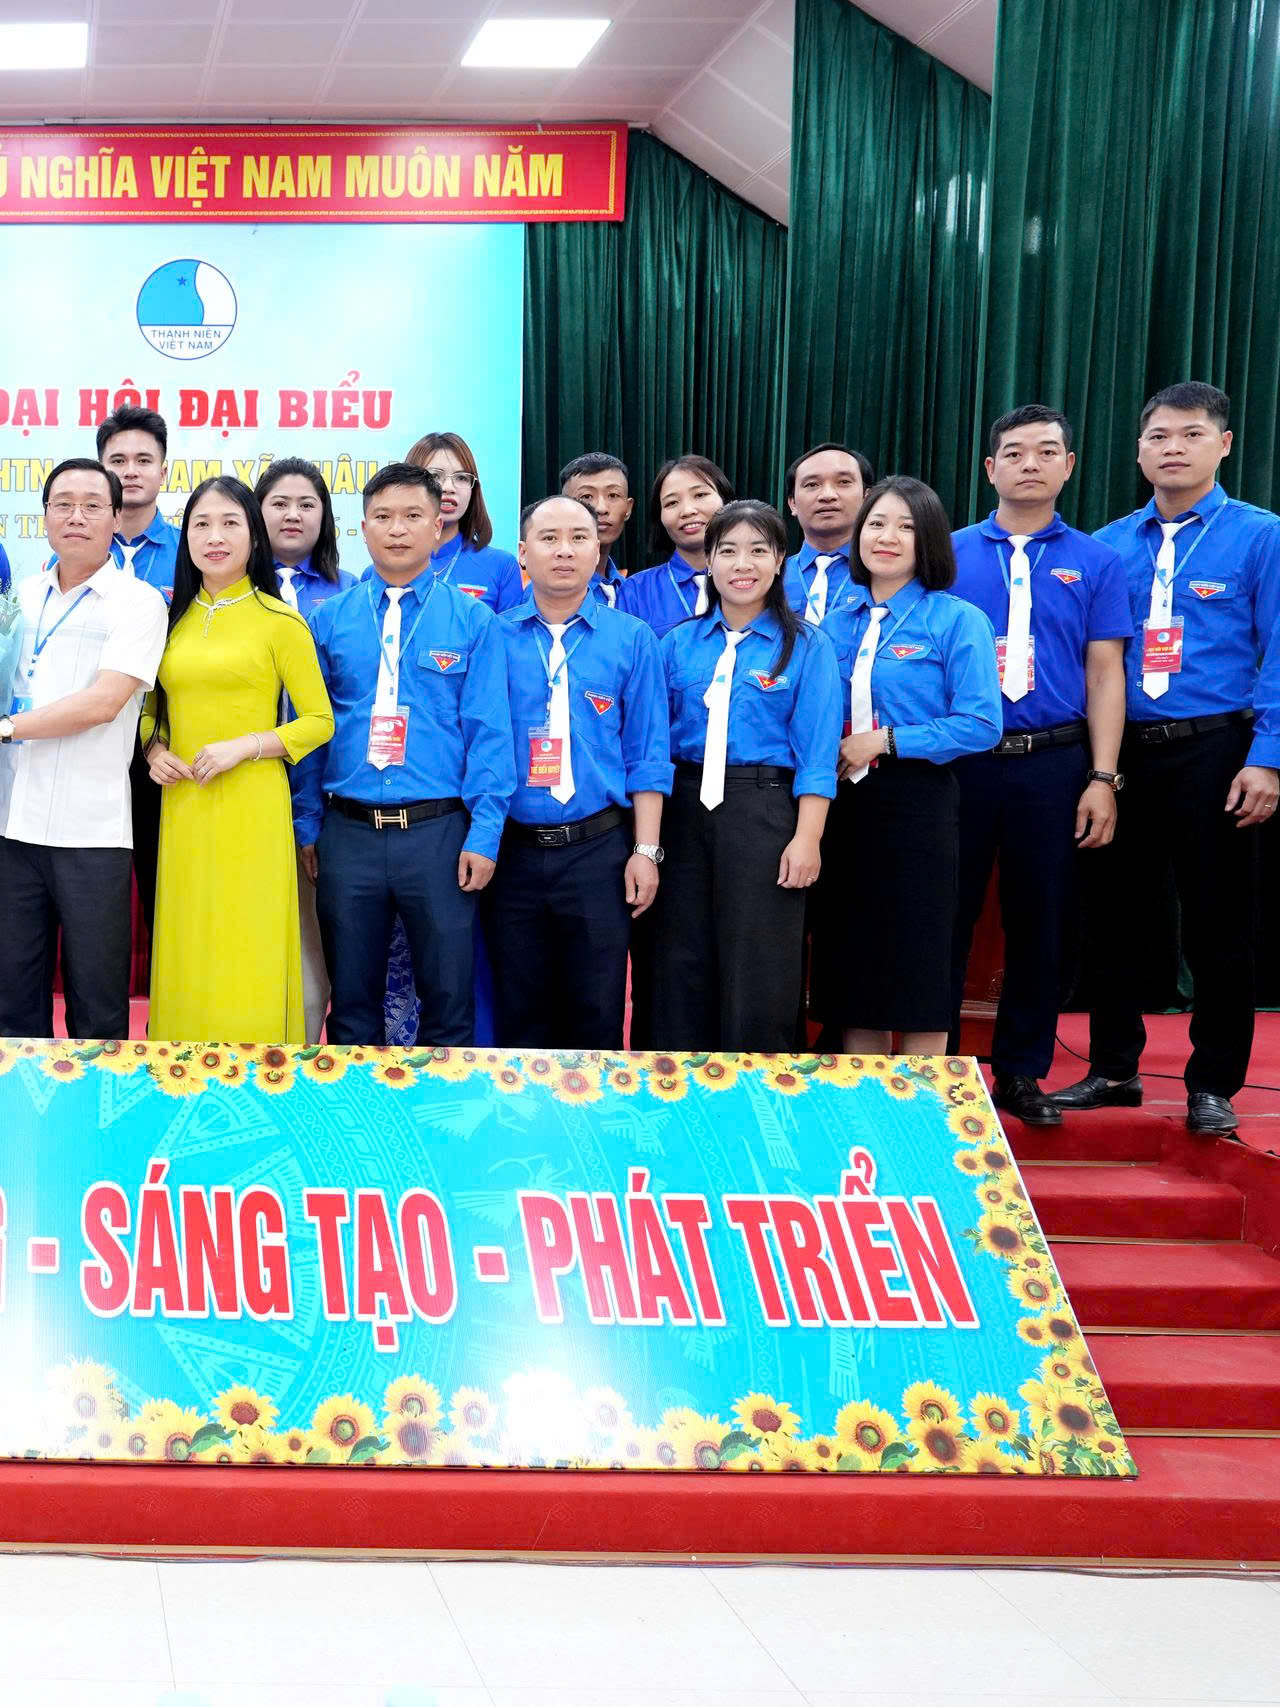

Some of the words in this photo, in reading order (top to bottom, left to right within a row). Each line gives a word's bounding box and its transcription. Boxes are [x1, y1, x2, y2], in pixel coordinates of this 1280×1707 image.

[21, 147, 138, 199] NGHĨA
[151, 146, 232, 208] VIỆT
[242, 154, 332, 199] NAM
[345, 145, 461, 199] MUÔN
[474, 144, 564, 198] NĂM
[151, 329, 190, 339] THANH
[193, 327, 221, 339] NIÊN
[188, 341, 213, 350] NAM
[178, 388, 259, 438] ĐẠI
[277, 369, 393, 429] BIỂU
[82, 1161, 293, 1317] SÁNG
[305, 1190, 456, 1347] TẠO
[518, 1170, 724, 1321] PHÁT
[725, 1149, 978, 1325] TRIỂN
